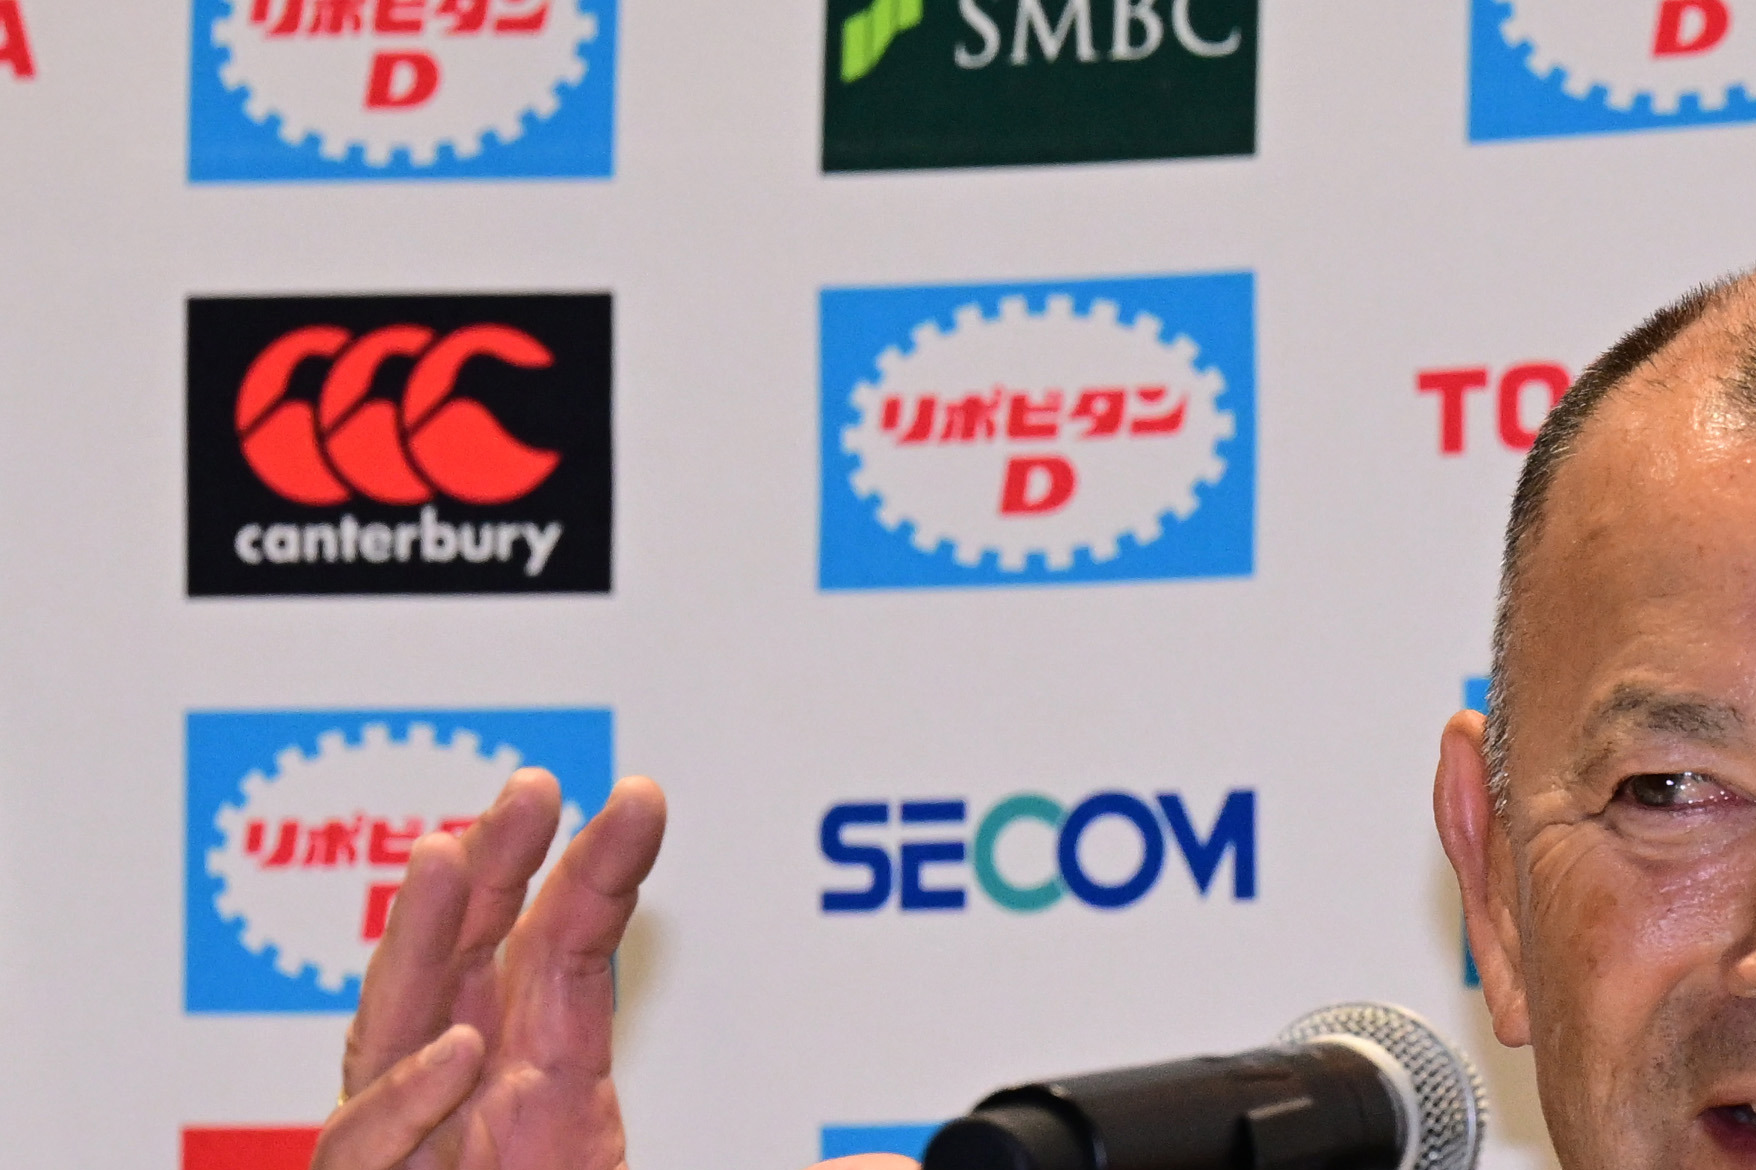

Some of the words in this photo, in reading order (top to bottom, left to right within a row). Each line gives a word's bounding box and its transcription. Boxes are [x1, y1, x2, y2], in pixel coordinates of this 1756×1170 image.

[954, 0, 1242, 69] SMBC
[1651, 0, 1732, 58] D
[363, 50, 441, 110] D
[879, 385, 1188, 446] リポビタン
[998, 455, 1078, 517] D
[234, 504, 562, 576] canterbury
[818, 789, 1258, 914] SECOM
